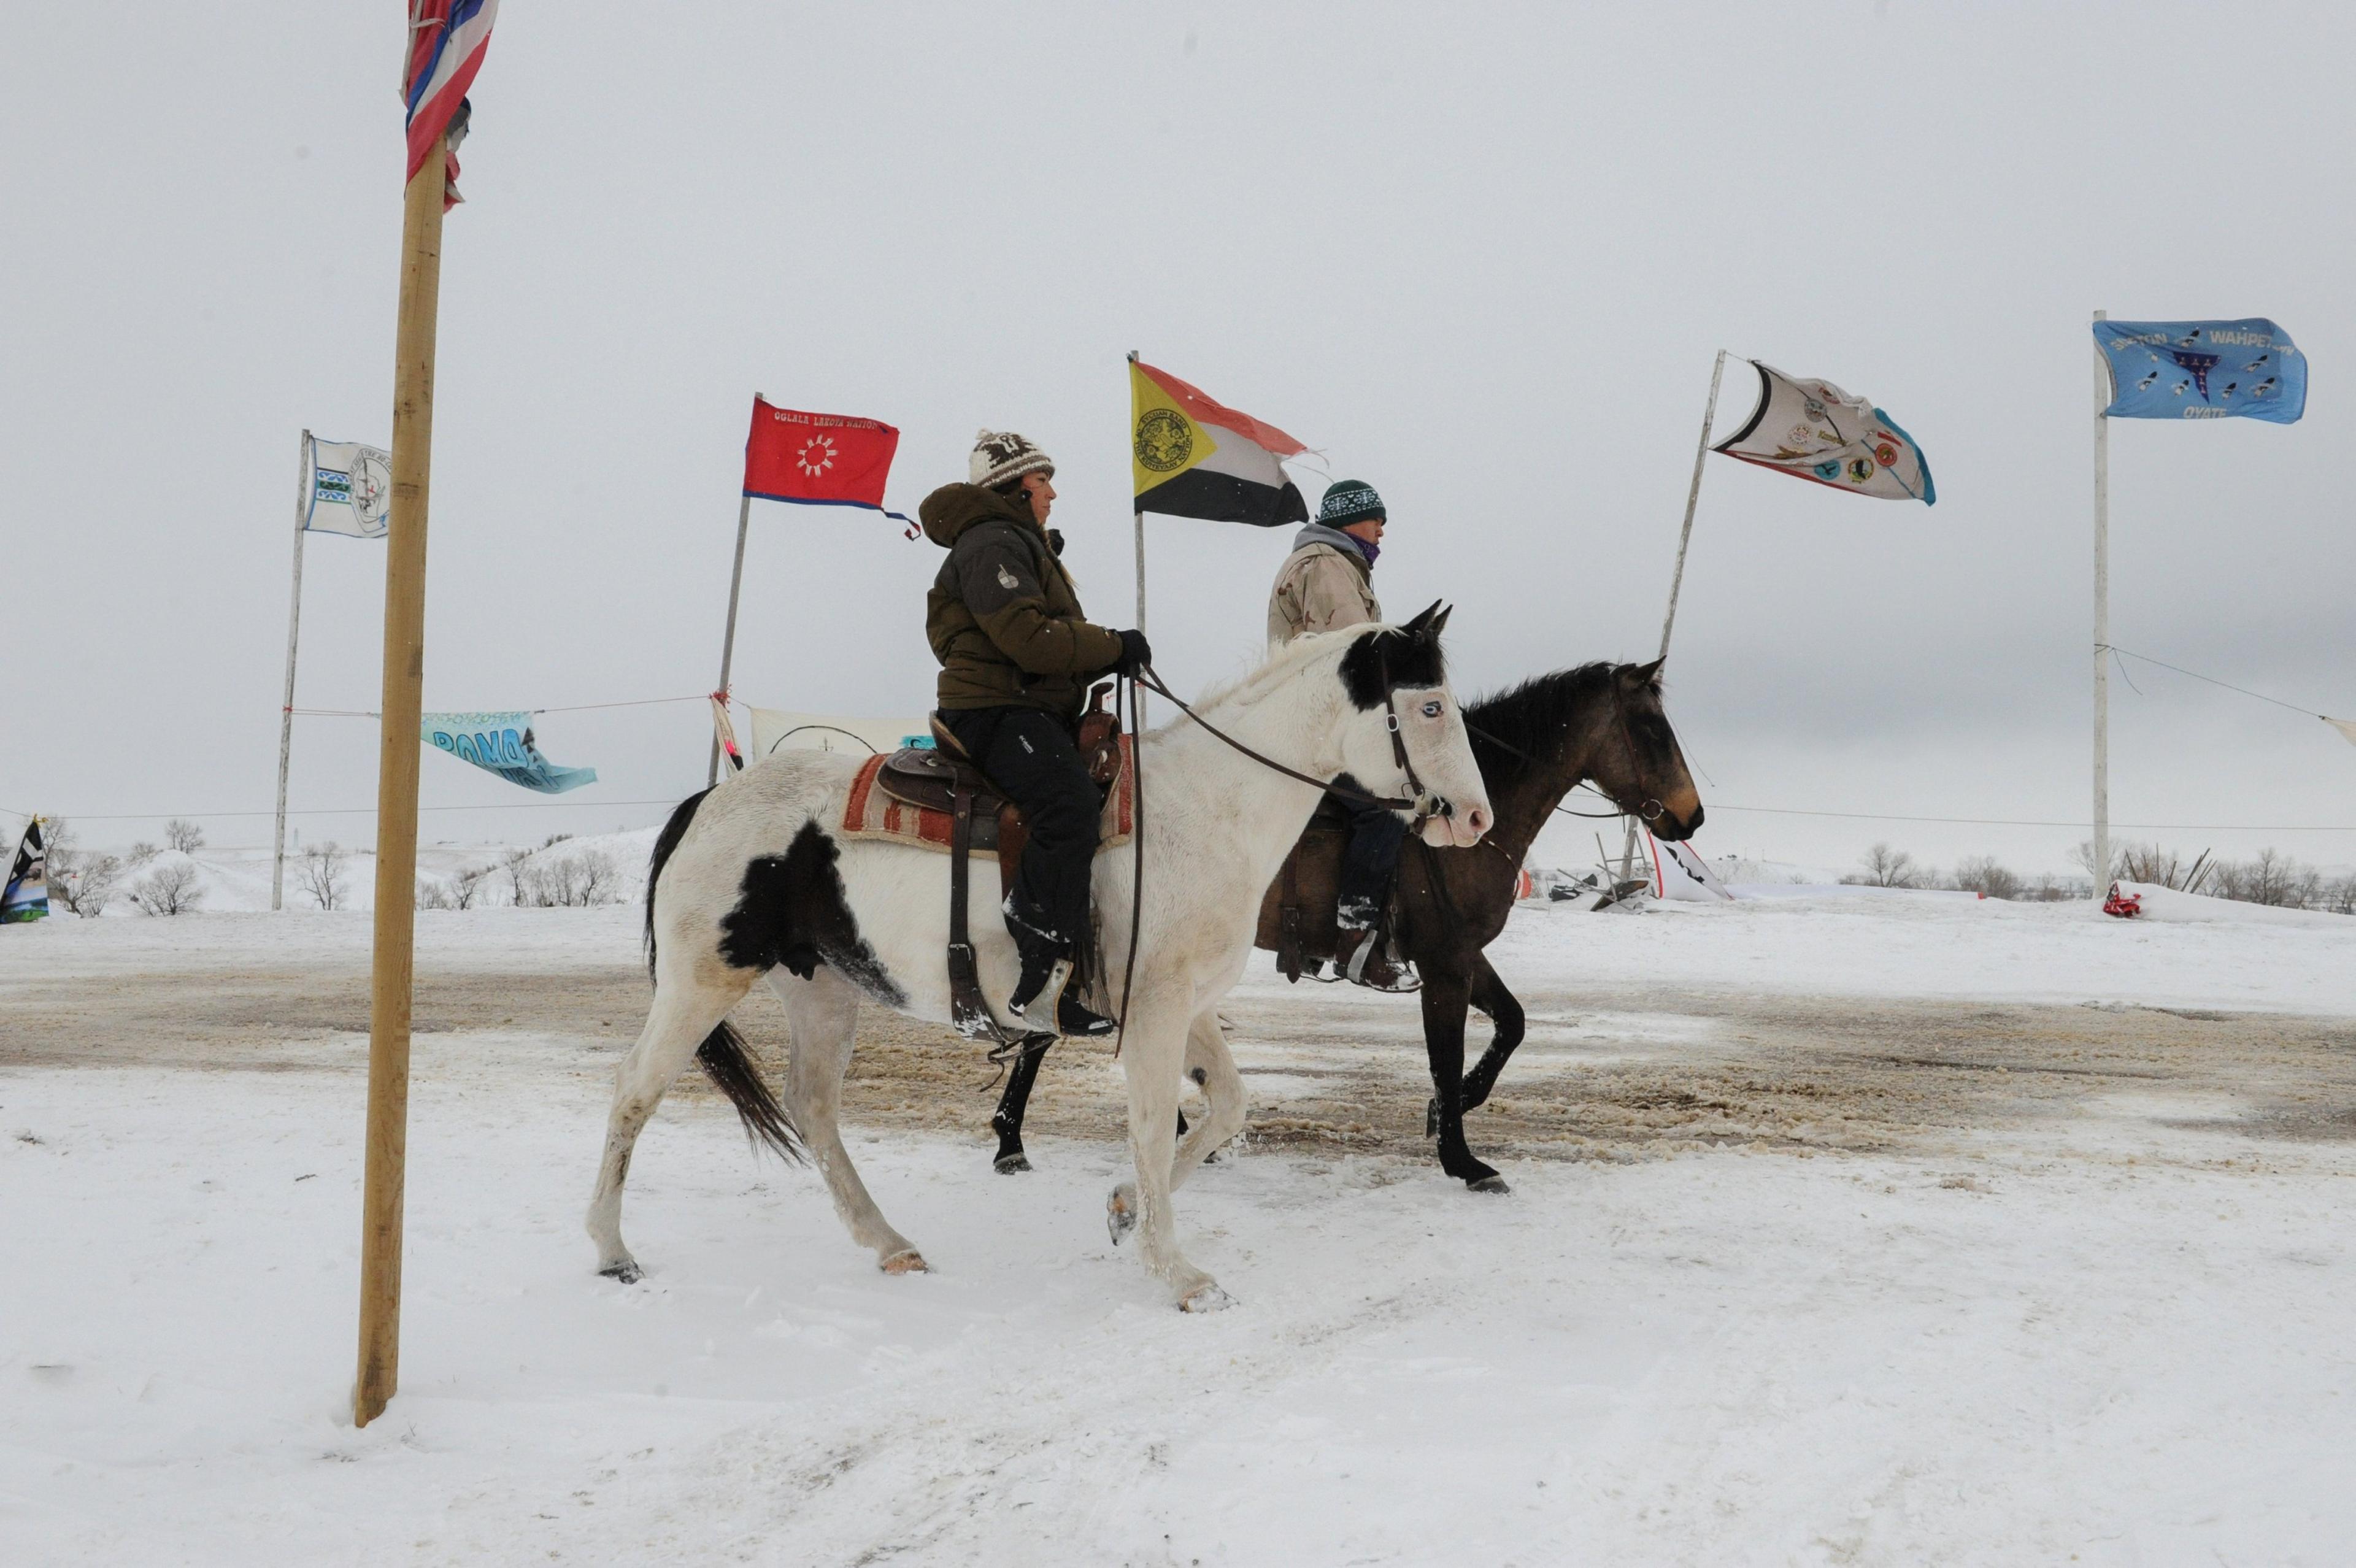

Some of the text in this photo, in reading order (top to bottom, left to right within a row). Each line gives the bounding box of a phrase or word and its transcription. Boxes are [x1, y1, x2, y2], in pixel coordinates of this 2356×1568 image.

[774, 412, 809, 424] OGLALA
[814, 417, 844, 427] LAKOTA
[2183, 405, 2227, 418] OYATE
[1141, 411, 1186, 429] SYCUAN BAND
[1142, 456, 1177, 469] KUMEYAAY
[1179, 435, 1190, 462] NATION
